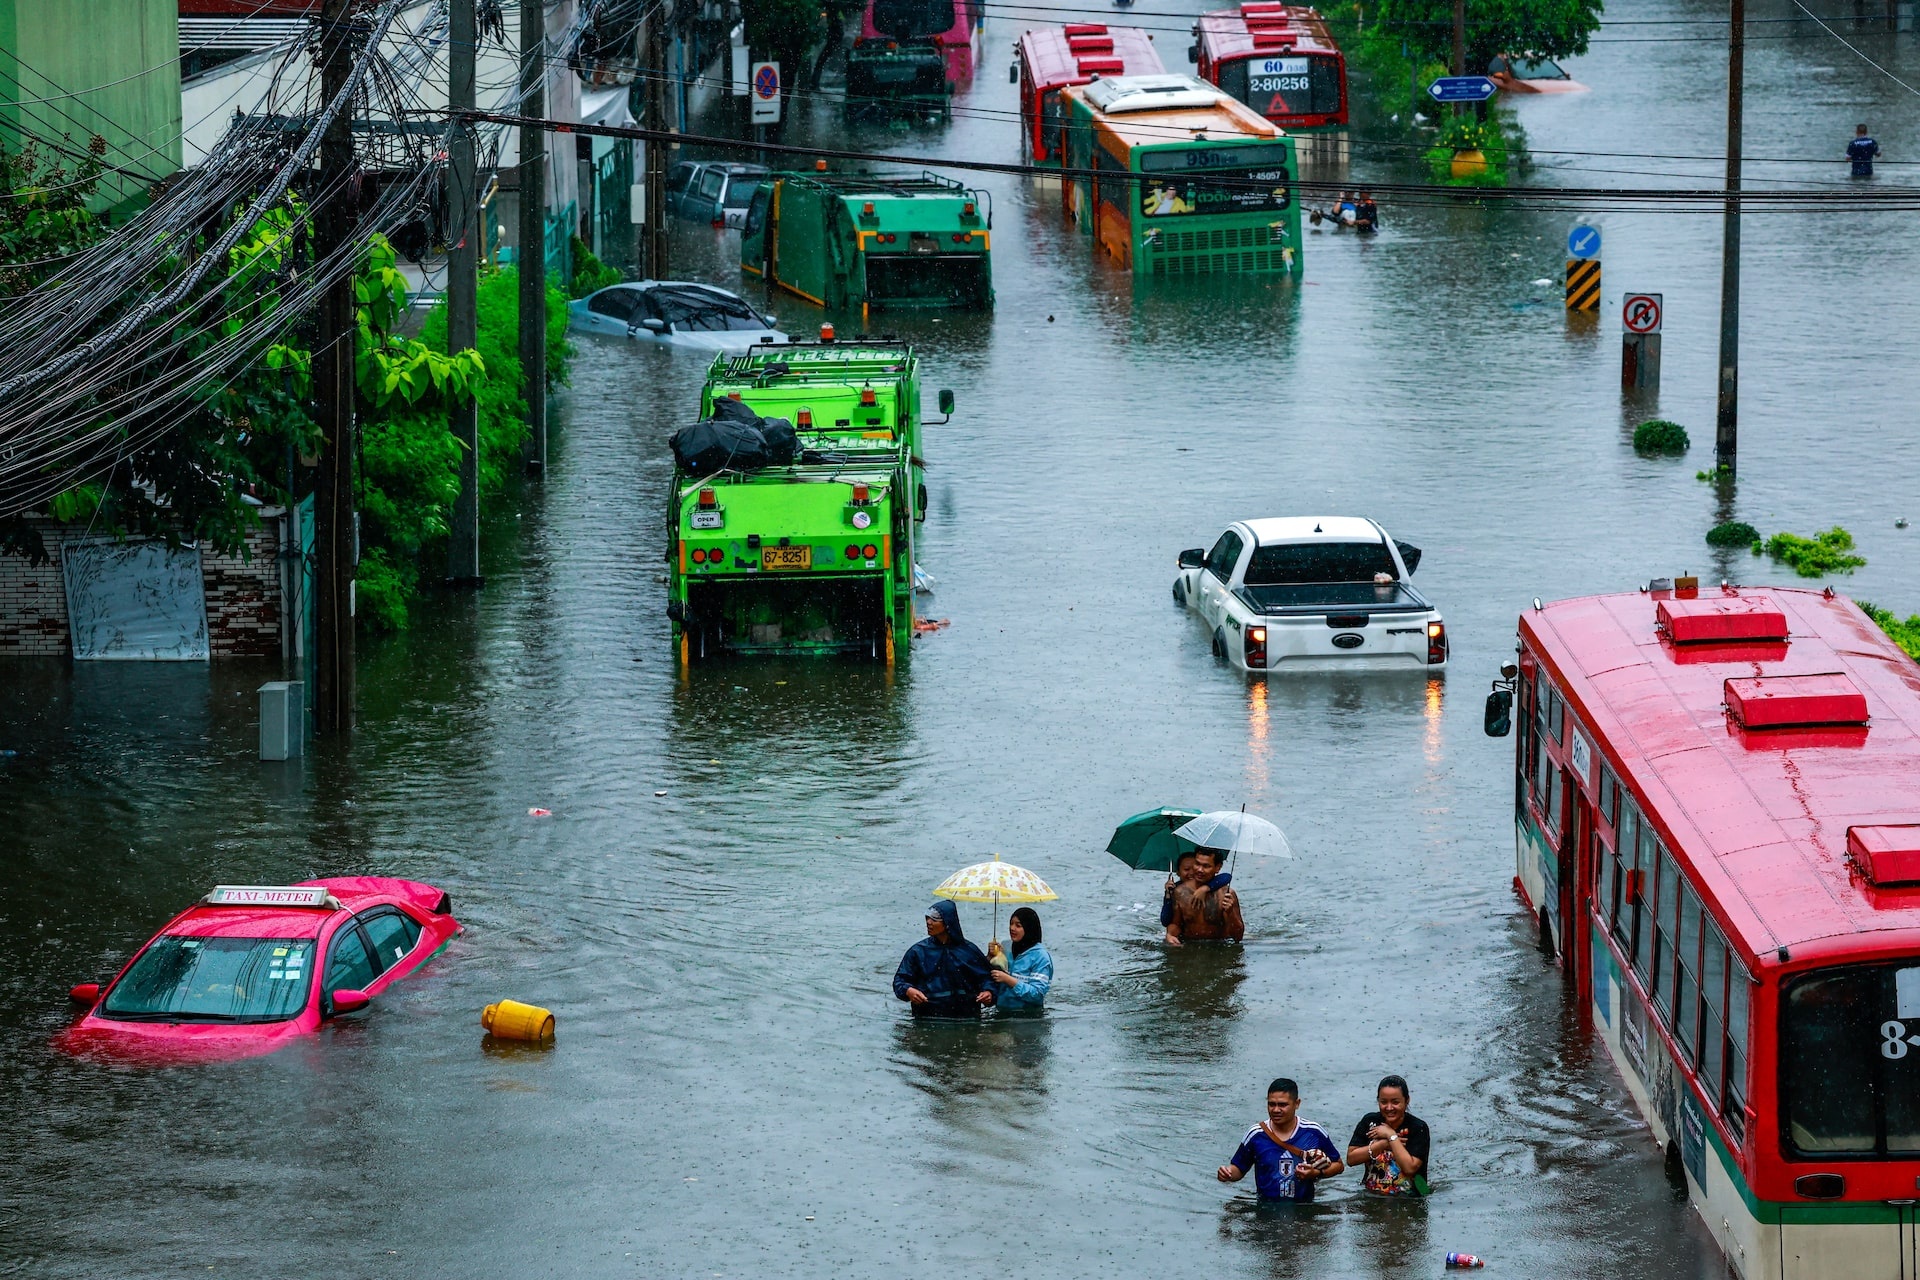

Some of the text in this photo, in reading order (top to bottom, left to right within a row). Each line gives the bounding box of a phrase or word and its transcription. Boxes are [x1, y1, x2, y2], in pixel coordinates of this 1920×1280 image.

[1264, 60, 1283, 73] 60
[1251, 77, 1309, 91] 2-80256
[764, 551, 807, 563] 67-8251
[225, 892, 313, 902] TAXI-METER
